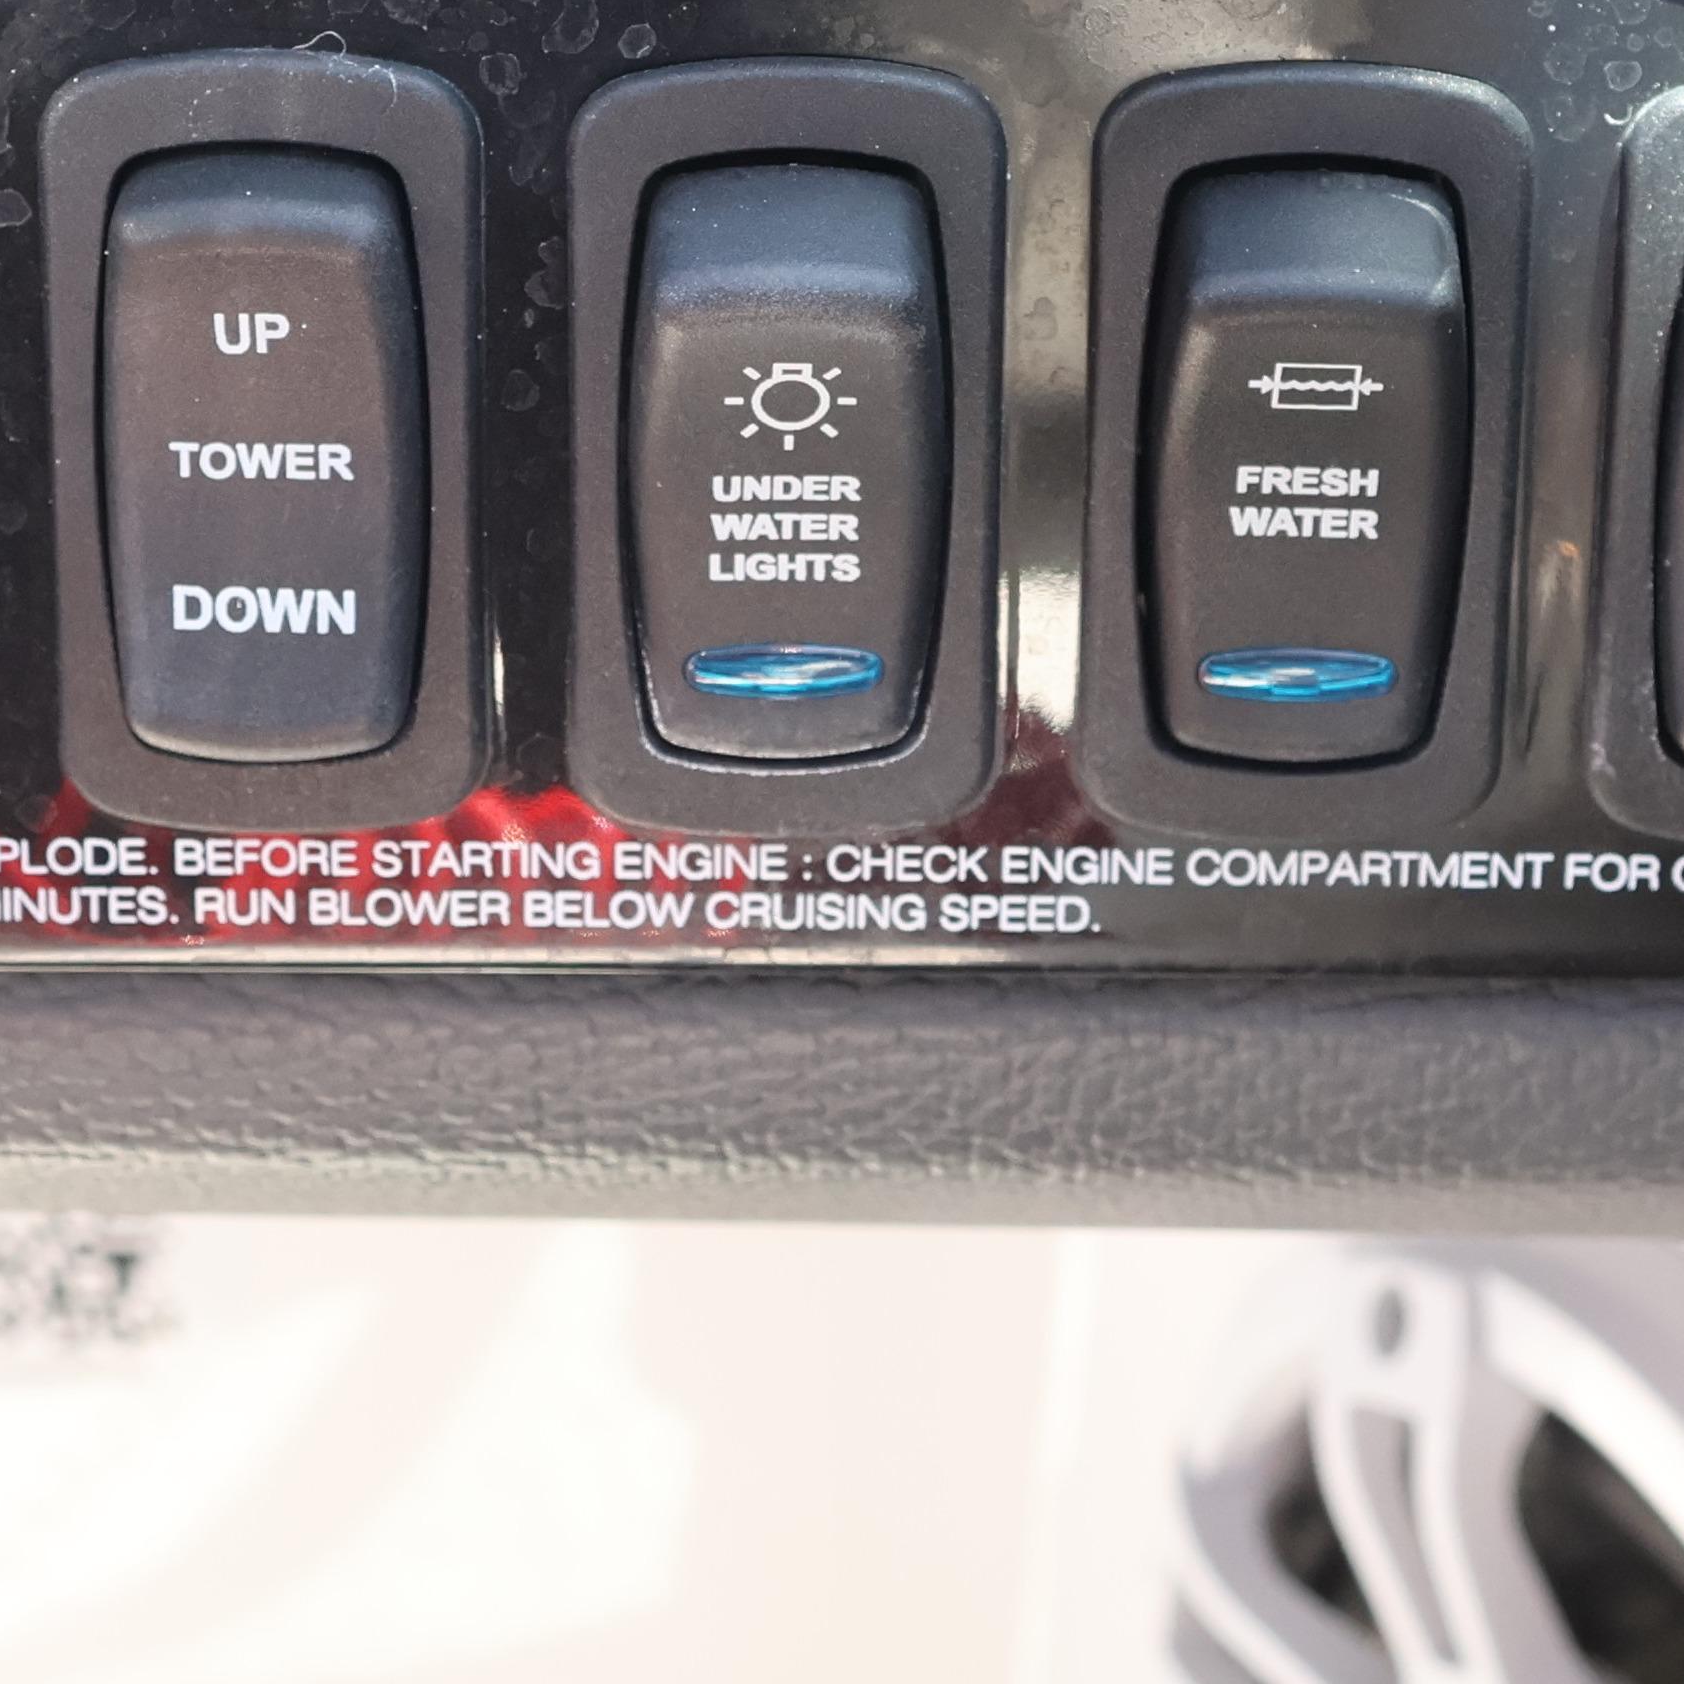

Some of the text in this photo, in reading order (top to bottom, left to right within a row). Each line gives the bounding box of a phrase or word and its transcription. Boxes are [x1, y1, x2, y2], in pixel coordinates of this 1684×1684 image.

[212, 312, 290, 355] UP
[169, 441, 354, 481] TOWER
[711, 474, 861, 503] UNDER
[1235, 466, 1380, 498] FRESH
[710, 513, 859, 541] WATER
[1228, 506, 1379, 539] WATER
[708, 552, 861, 583] LIGHTS
[171, 584, 356, 635] DOWN
[175, 837, 358, 878] BEFORE
[371, 841, 600, 880] STARTING
[614, 842, 788, 881] ENGINE
[804, 849, 813, 882] :
[826, 844, 988, 884] CHECK
[1001, 846, 1173, 886] ENGINE
[1186, 848, 1554, 890] COMPARTMENT
[1564, 854, 1660, 892] FOR
[196, 889, 295, 926] RUN
[309, 890, 511, 927] BLOWER
[525, 891, 696, 929] BELOW
[704, 893, 927, 931] CRUISING
[939, 896, 1101, 934] SPEED.
